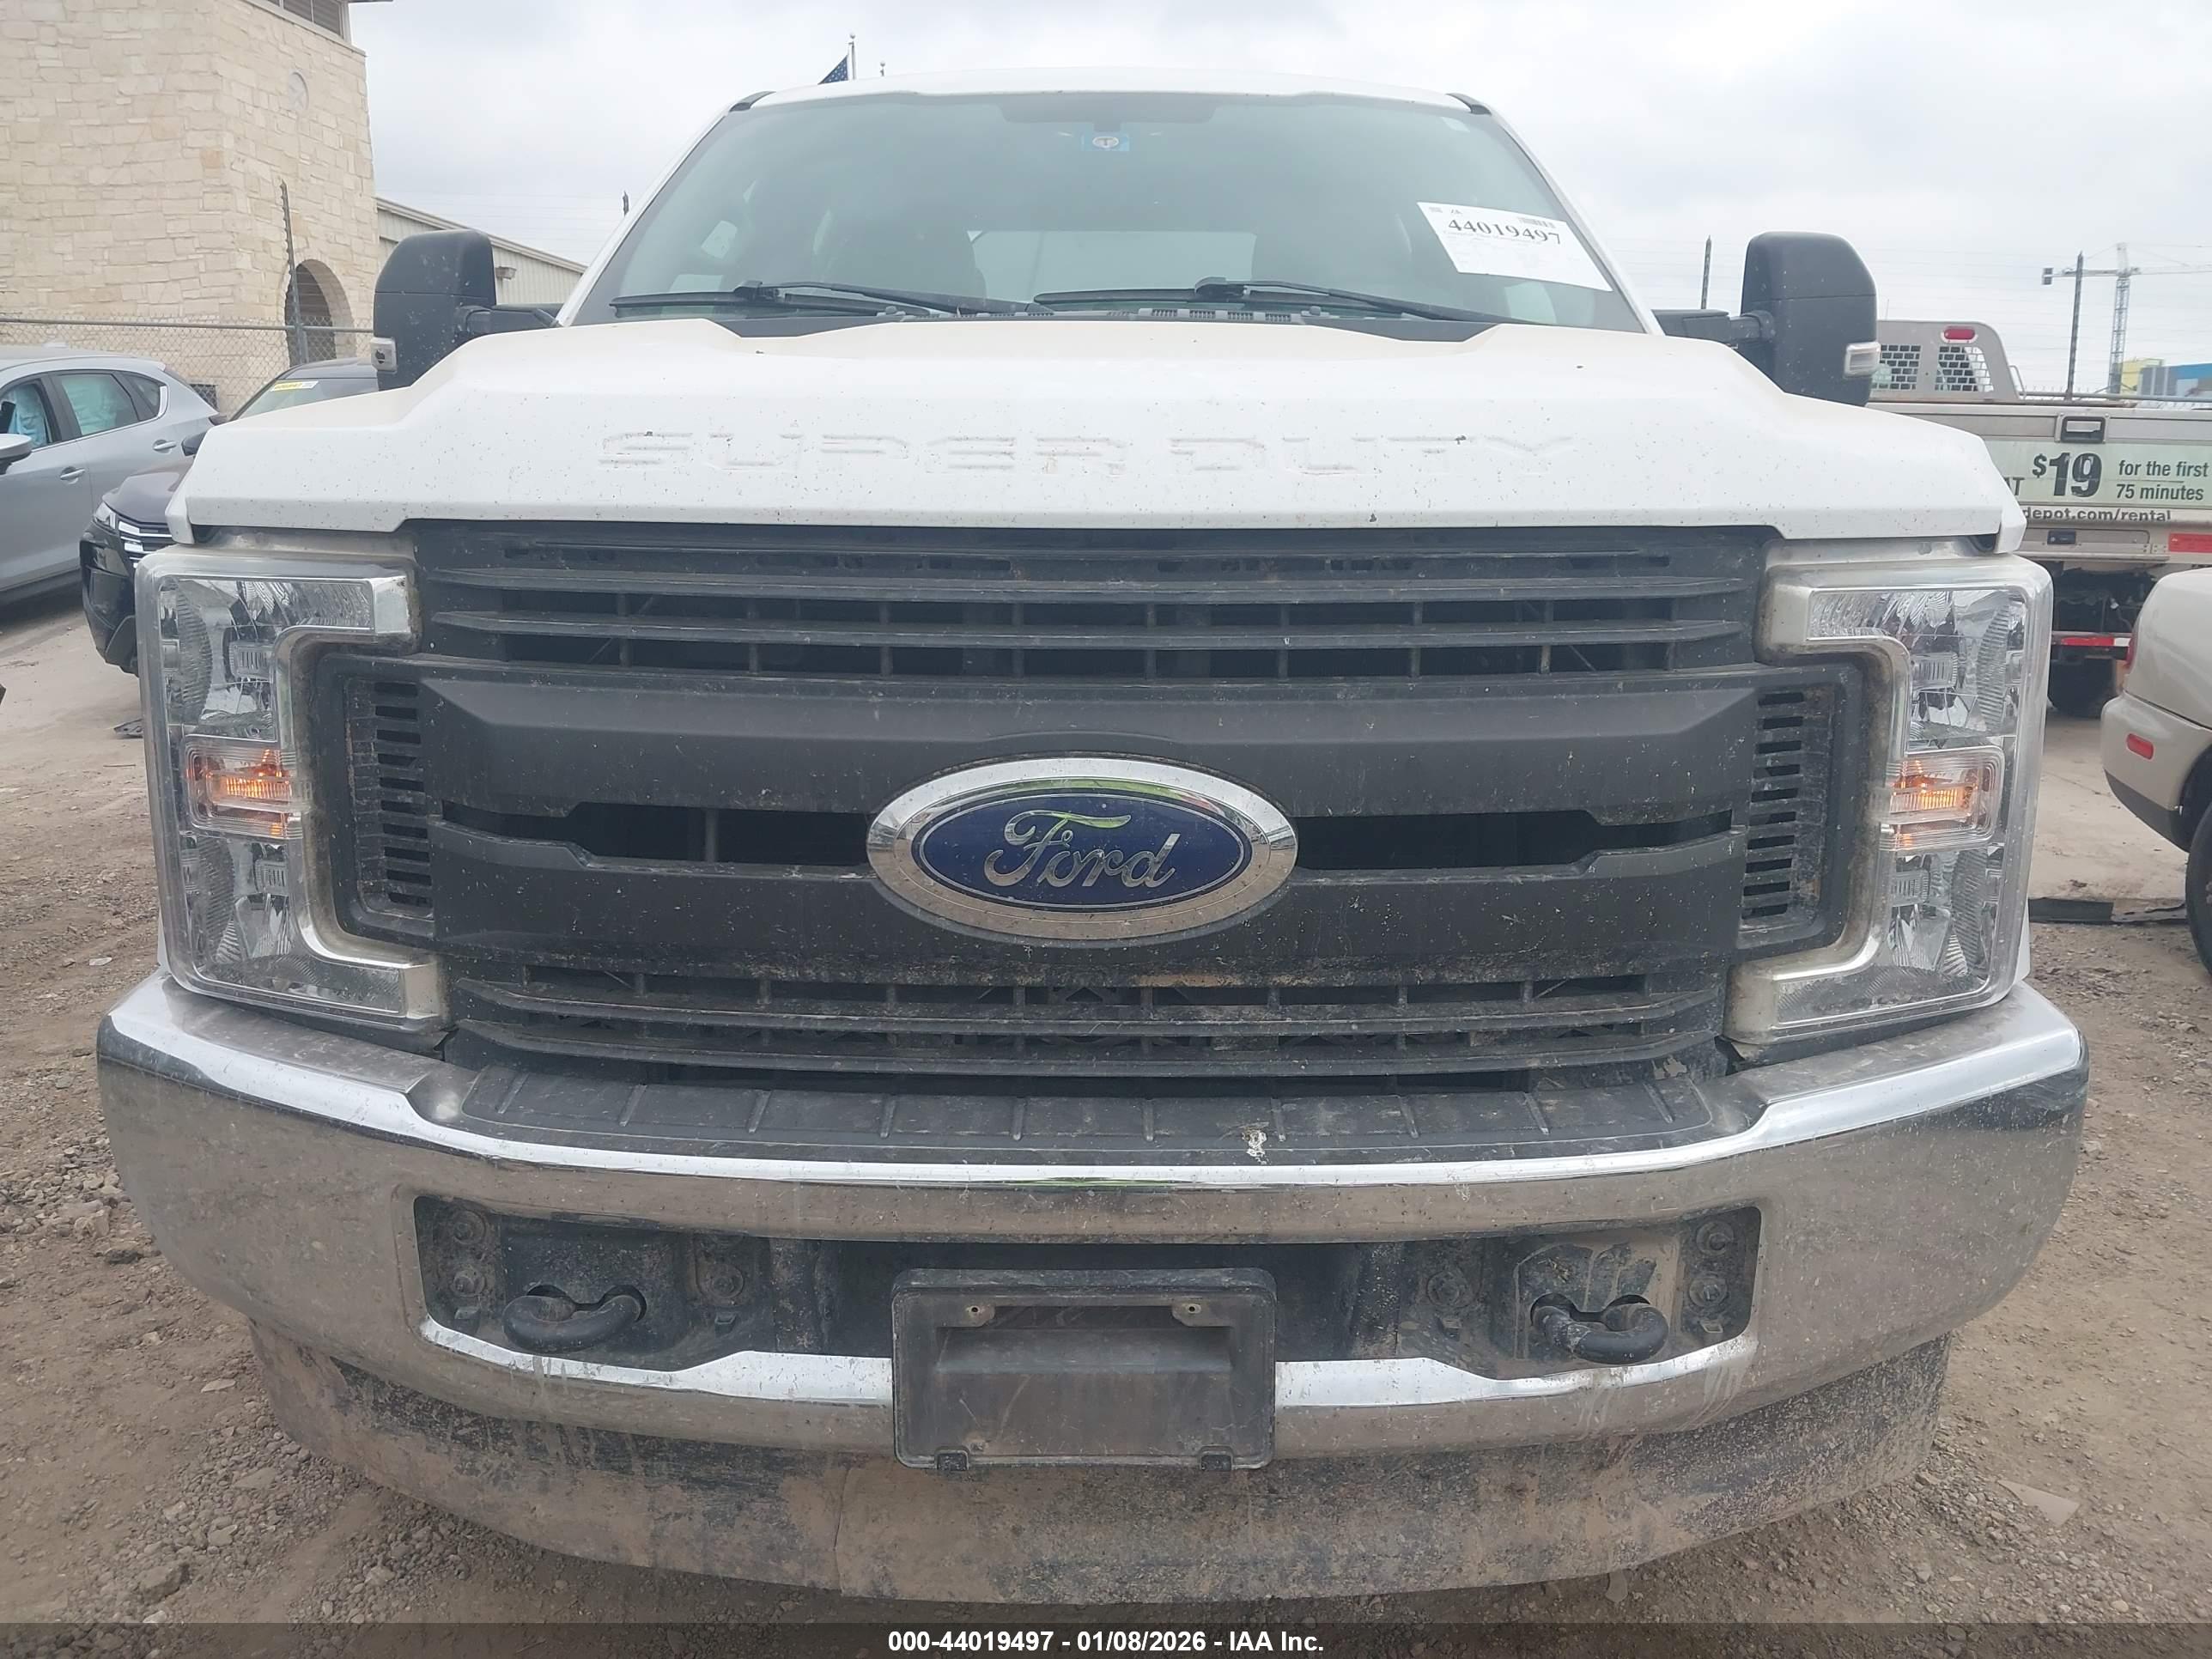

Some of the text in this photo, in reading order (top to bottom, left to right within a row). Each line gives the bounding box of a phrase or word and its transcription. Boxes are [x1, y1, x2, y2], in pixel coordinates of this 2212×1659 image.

[1449, 219, 1561, 245] 44019497
[598, 431, 1575, 477] SUPER DUTY
[2118, 459, 2209, 477] for the first
[2032, 452, 2103, 498] $19
[2117, 483, 2204, 501] 75 minutes
[983, 809, 1181, 888] Ford
